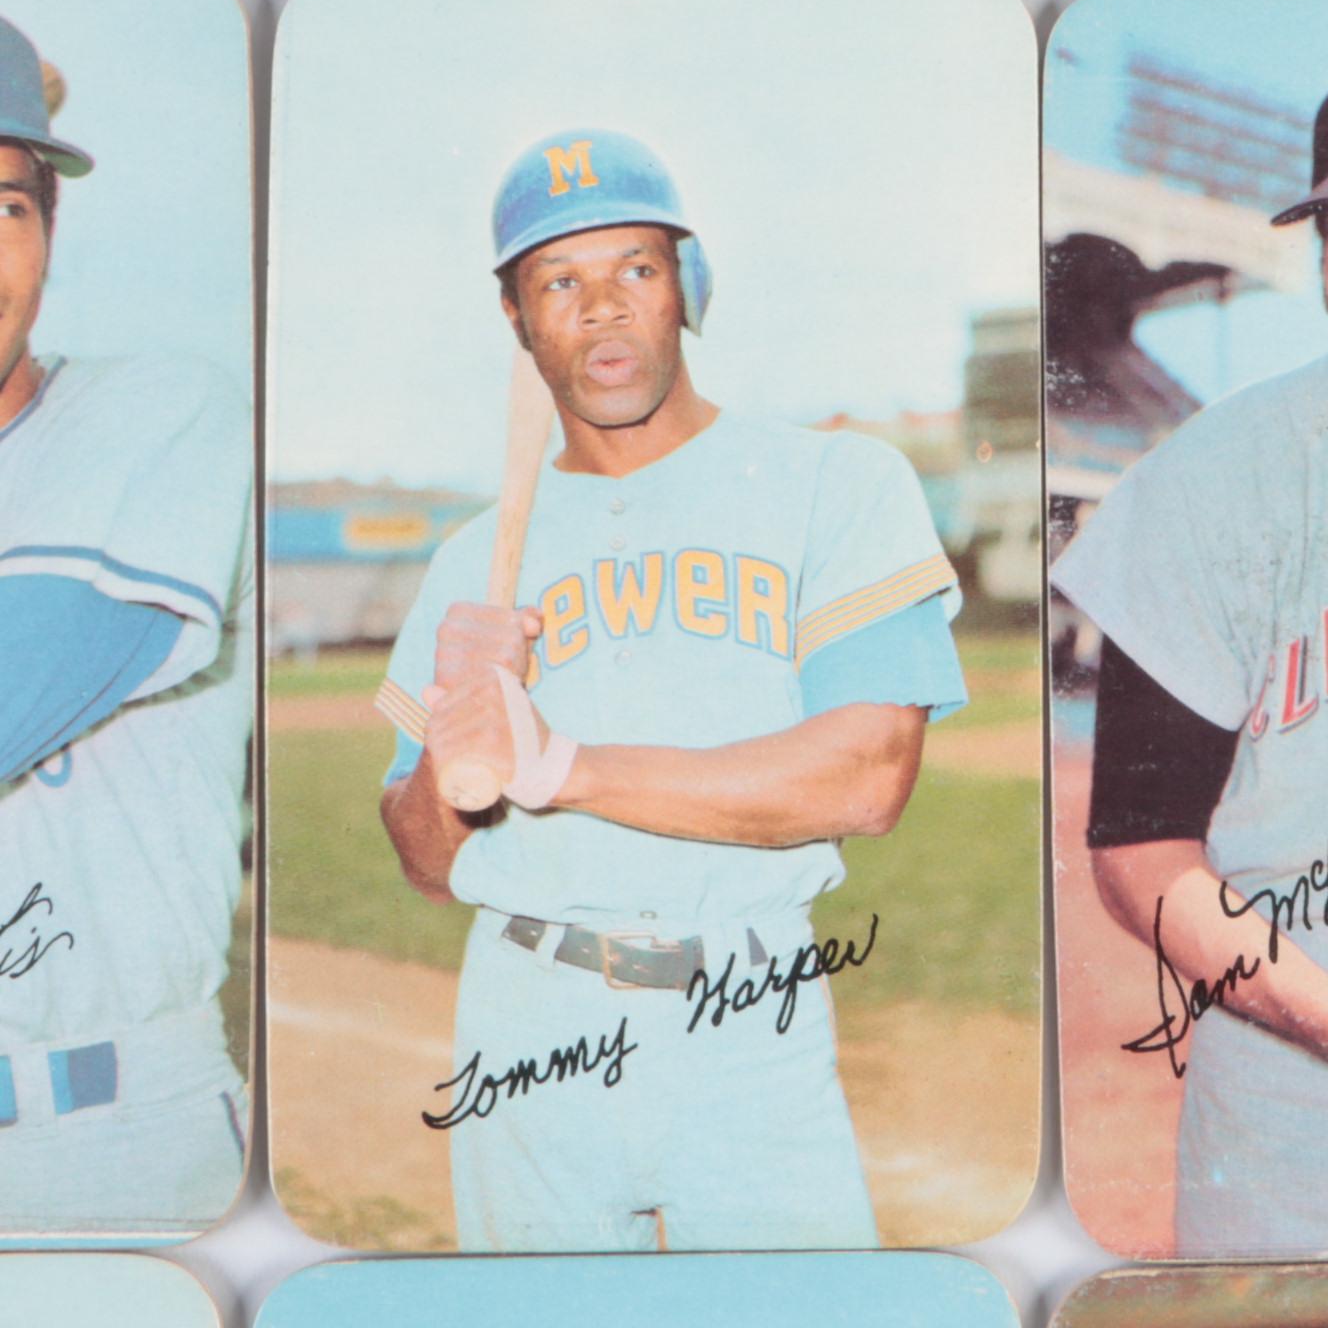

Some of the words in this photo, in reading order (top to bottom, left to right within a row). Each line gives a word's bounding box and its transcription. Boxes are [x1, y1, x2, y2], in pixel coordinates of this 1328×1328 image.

[543, 139, 599, 197] M
[421, 1016, 638, 1130] Tommy
[686, 913, 879, 1035] Harper
[1121, 895, 1261, 1079] Sam
